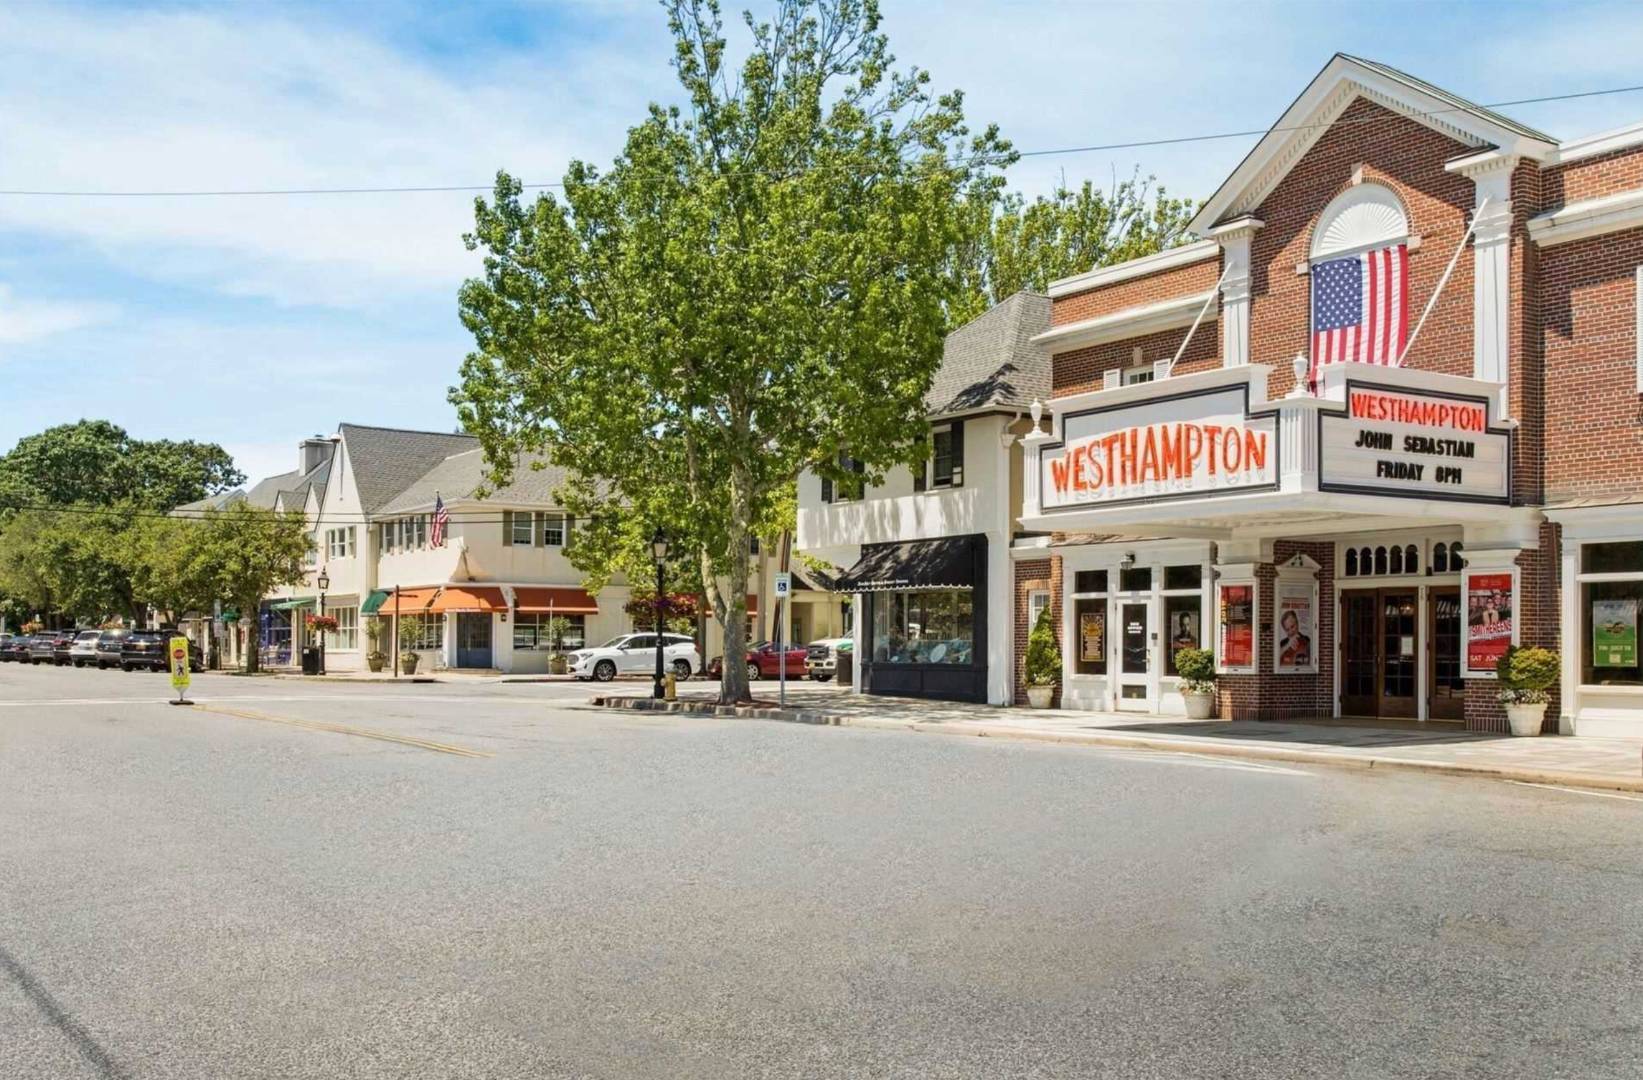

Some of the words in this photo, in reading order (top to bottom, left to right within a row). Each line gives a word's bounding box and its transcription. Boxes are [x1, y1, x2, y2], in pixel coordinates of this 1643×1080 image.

[1351, 392, 1483, 431] WESTHAMPTON
[1051, 423, 1267, 493] WESTHAMPTON
[1355, 430, 1393, 450] JOHN
[1403, 435, 1475, 458] SEBASTIAN
[1376, 460, 1424, 481] FRIDAY
[1435, 466, 1462, 484] 8PM
